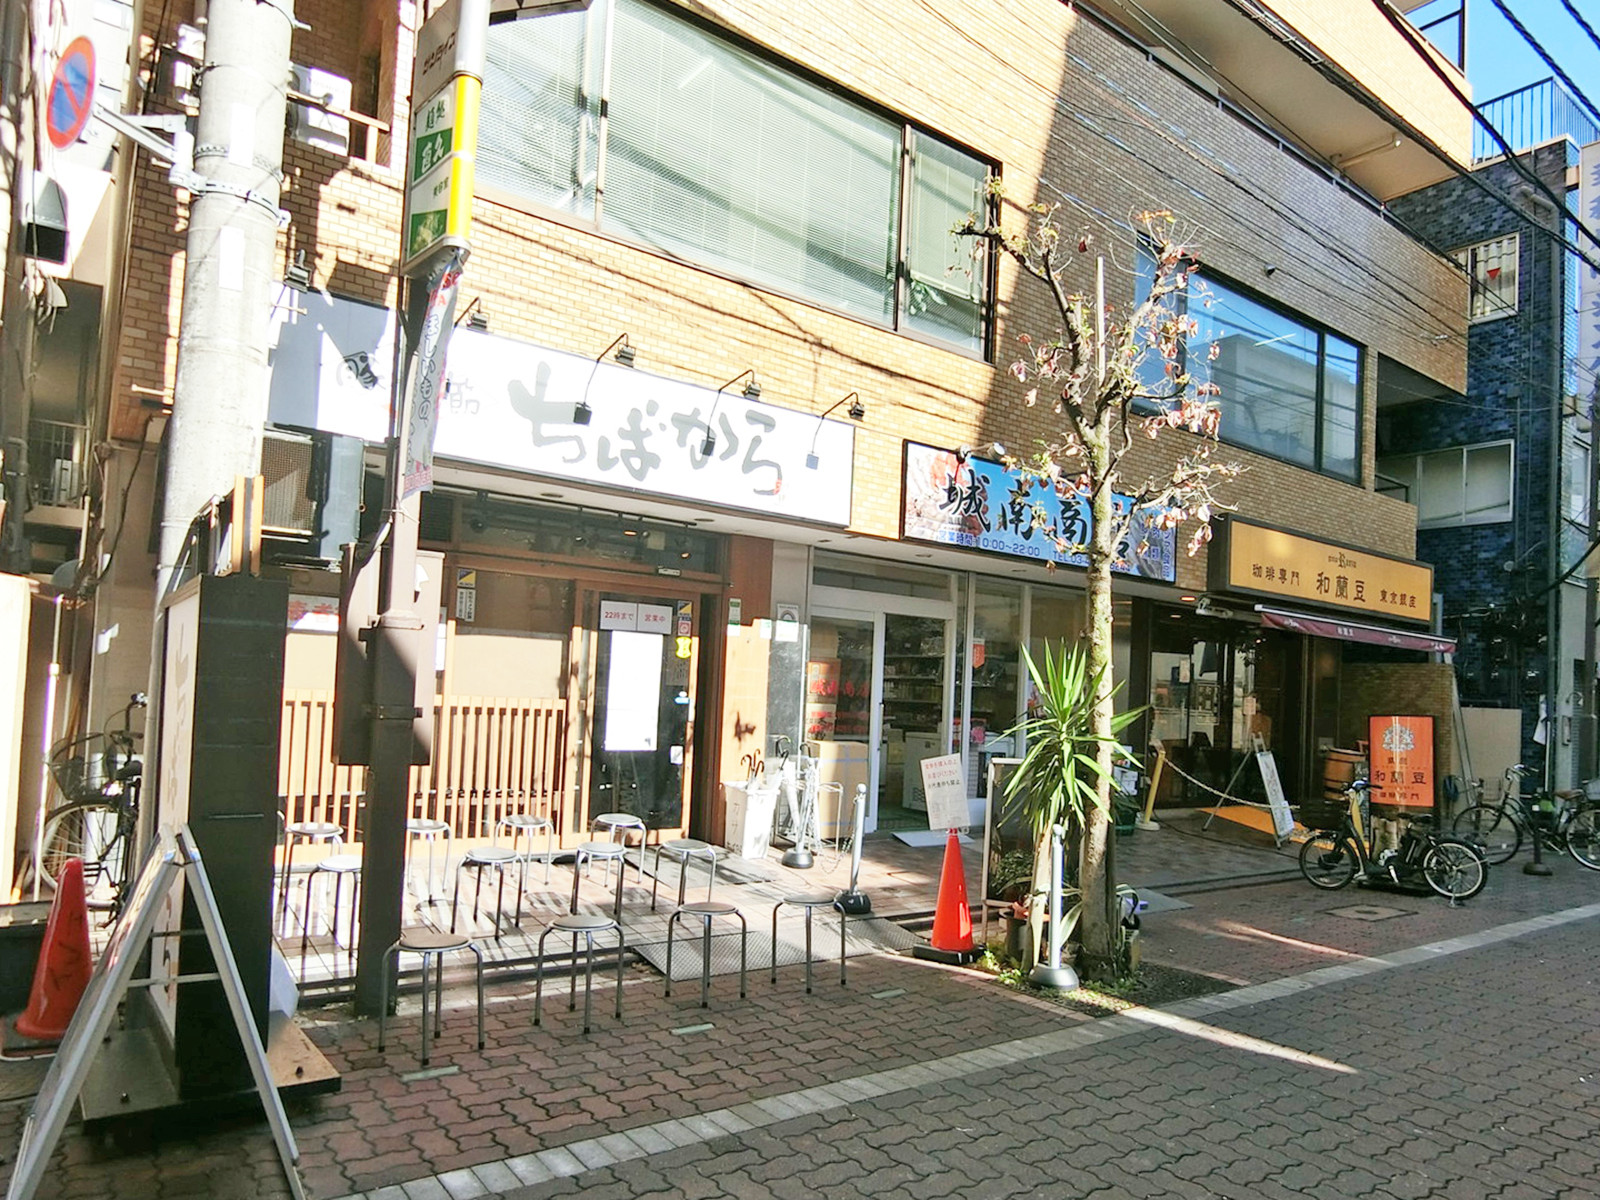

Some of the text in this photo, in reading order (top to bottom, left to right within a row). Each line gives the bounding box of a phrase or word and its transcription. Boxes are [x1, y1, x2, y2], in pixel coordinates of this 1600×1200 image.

[507, 360, 784, 496] ちばから
[1316, 571, 1367, 603] 和蘭豆
[644, 613, 666, 623] 営業中
